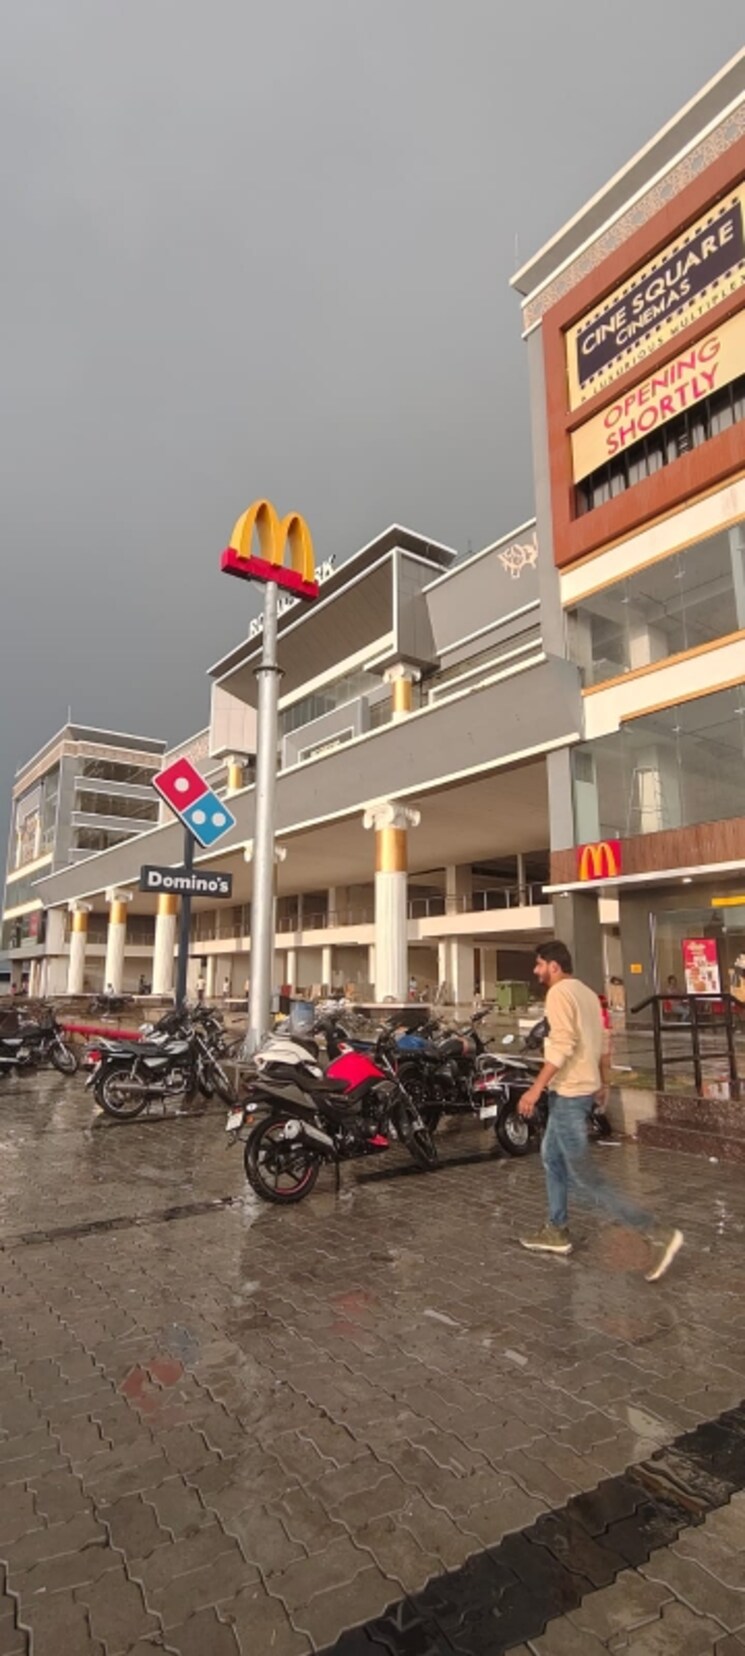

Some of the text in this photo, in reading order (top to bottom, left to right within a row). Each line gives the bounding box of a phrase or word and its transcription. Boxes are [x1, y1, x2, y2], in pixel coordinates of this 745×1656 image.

[581, 220, 734, 354] CINE SQUARE
[615, 279, 691, 345] CINEMAS
[593, 338, 663, 394] LUXURIOUS
[604, 336, 721, 429] OPENING
[606, 362, 719, 456] SHORTLY
[148, 871, 229, 893] Domino's
